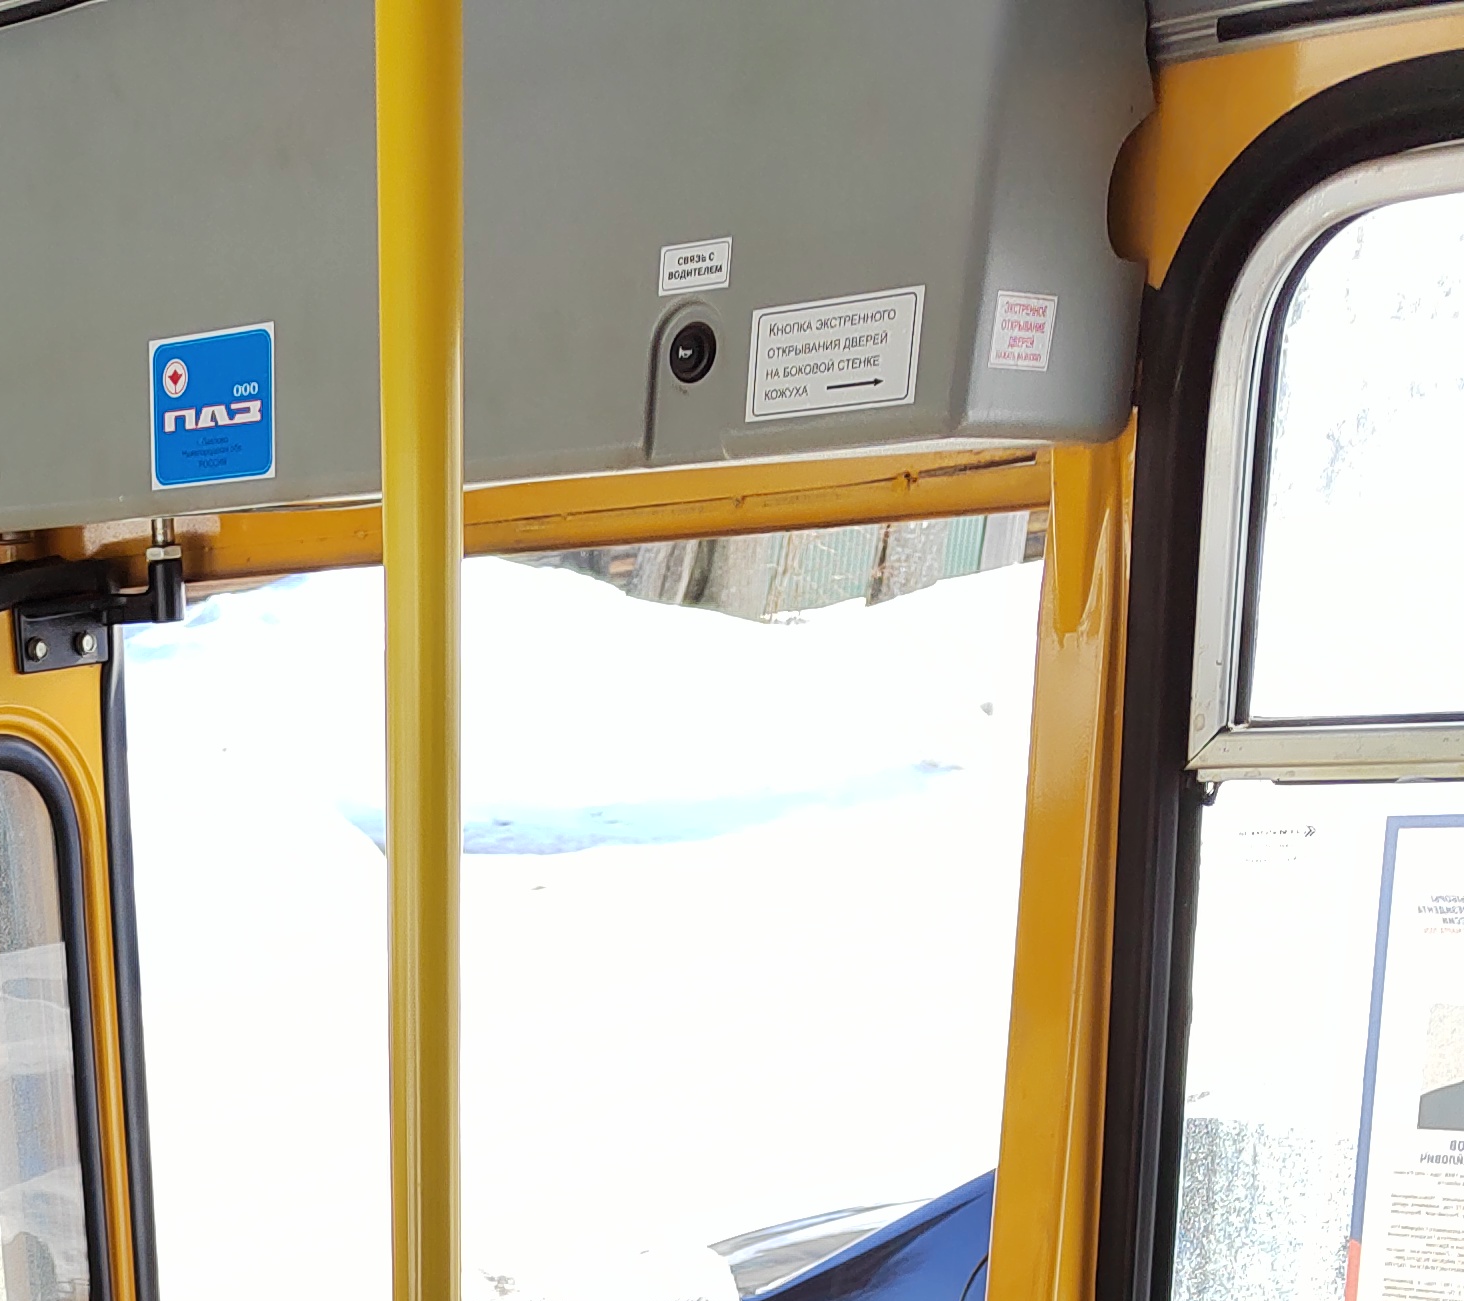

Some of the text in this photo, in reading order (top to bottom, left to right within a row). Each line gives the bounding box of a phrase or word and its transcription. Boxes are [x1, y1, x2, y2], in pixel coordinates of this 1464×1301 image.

[677, 252, 715, 266] СВЯЗЬ С
[667, 264, 723, 280] ВОДИТЕЛЕМ
[769, 308, 897, 337] КНОПКА ЭКСТРЕННОГО
[767, 330, 888, 359] ОТКРЫВАНИЯ ДВЕРЕЙ
[766, 355, 880, 380] НА БОКОВОЙ СТЕНКЕ
[764, 384, 809, 400] КОЖУХА
[163, 399, 262, 434] ПАЗ
